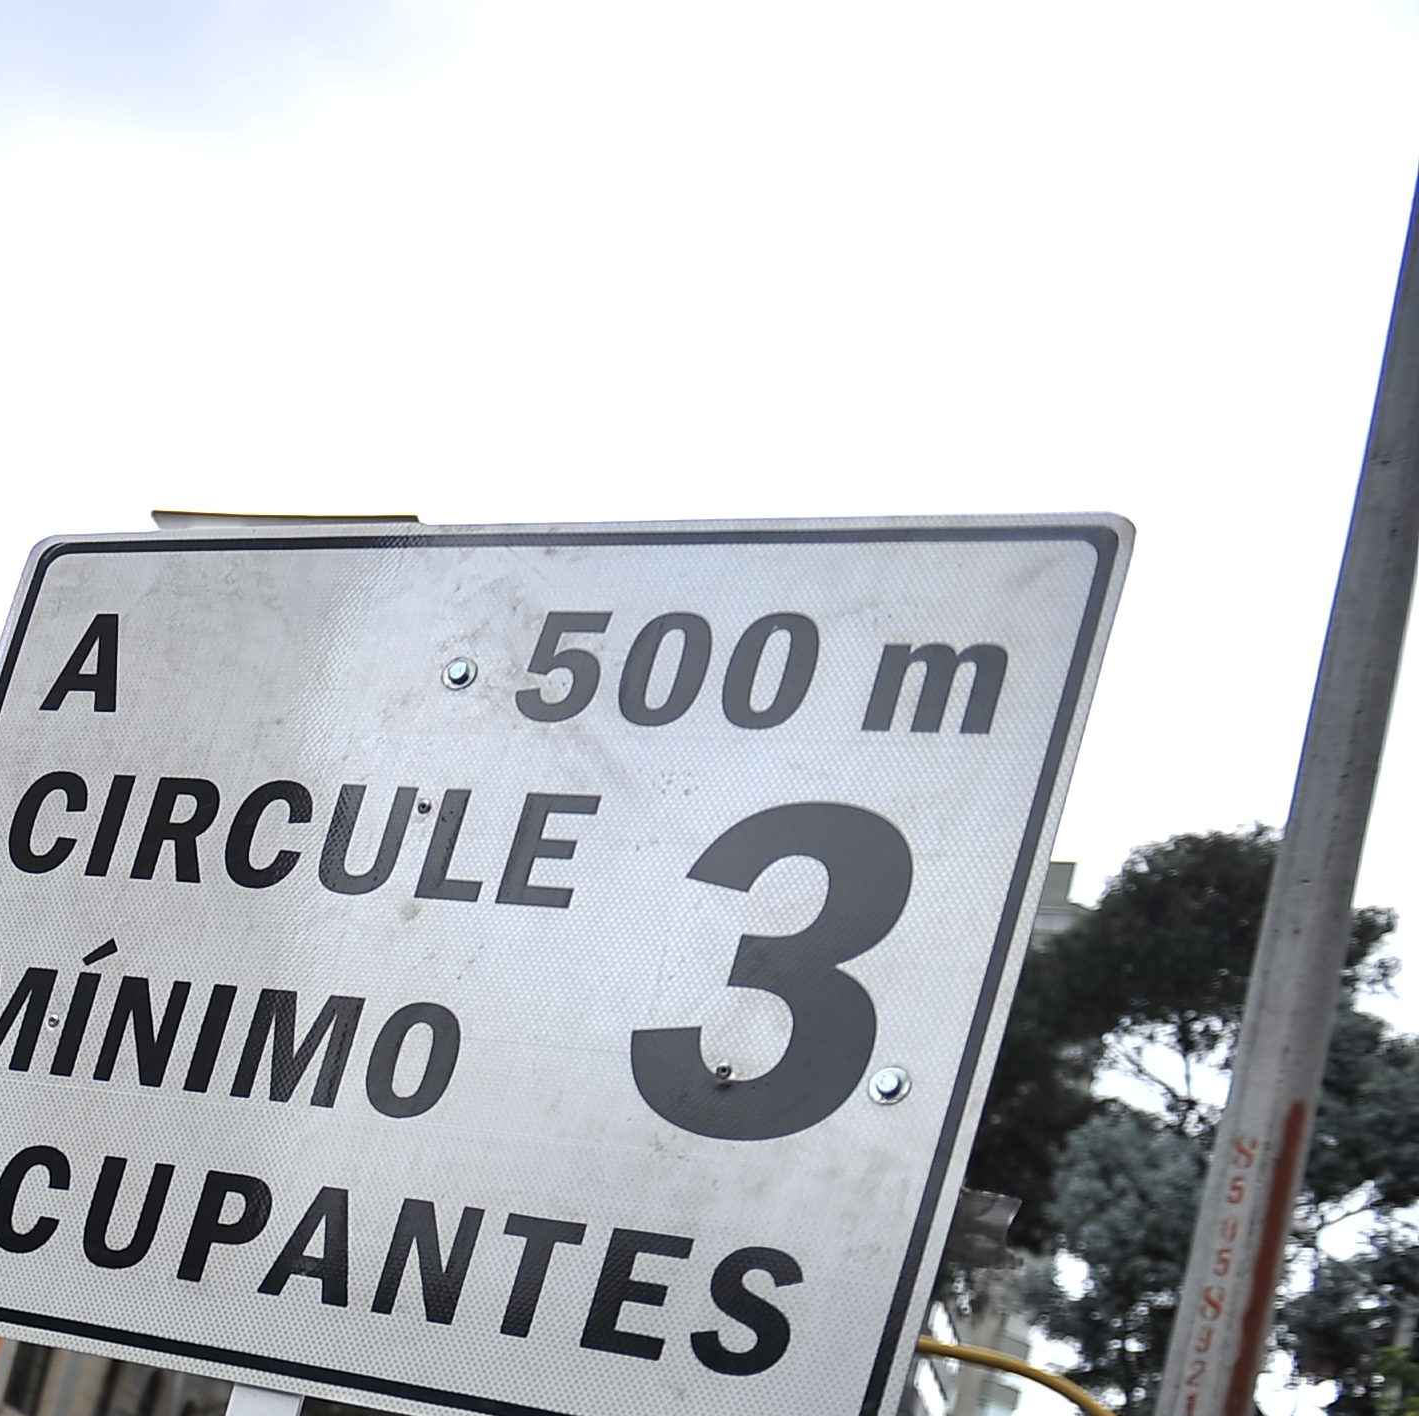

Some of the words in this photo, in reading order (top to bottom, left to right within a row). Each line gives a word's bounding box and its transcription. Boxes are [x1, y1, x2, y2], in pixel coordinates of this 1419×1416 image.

[40, 614, 118, 712] A
[517, 613, 818, 728] 500
[863, 645, 1007, 733] m
[9, 771, 600, 908] CIRCULE
[631, 804, 912, 1140] 3
